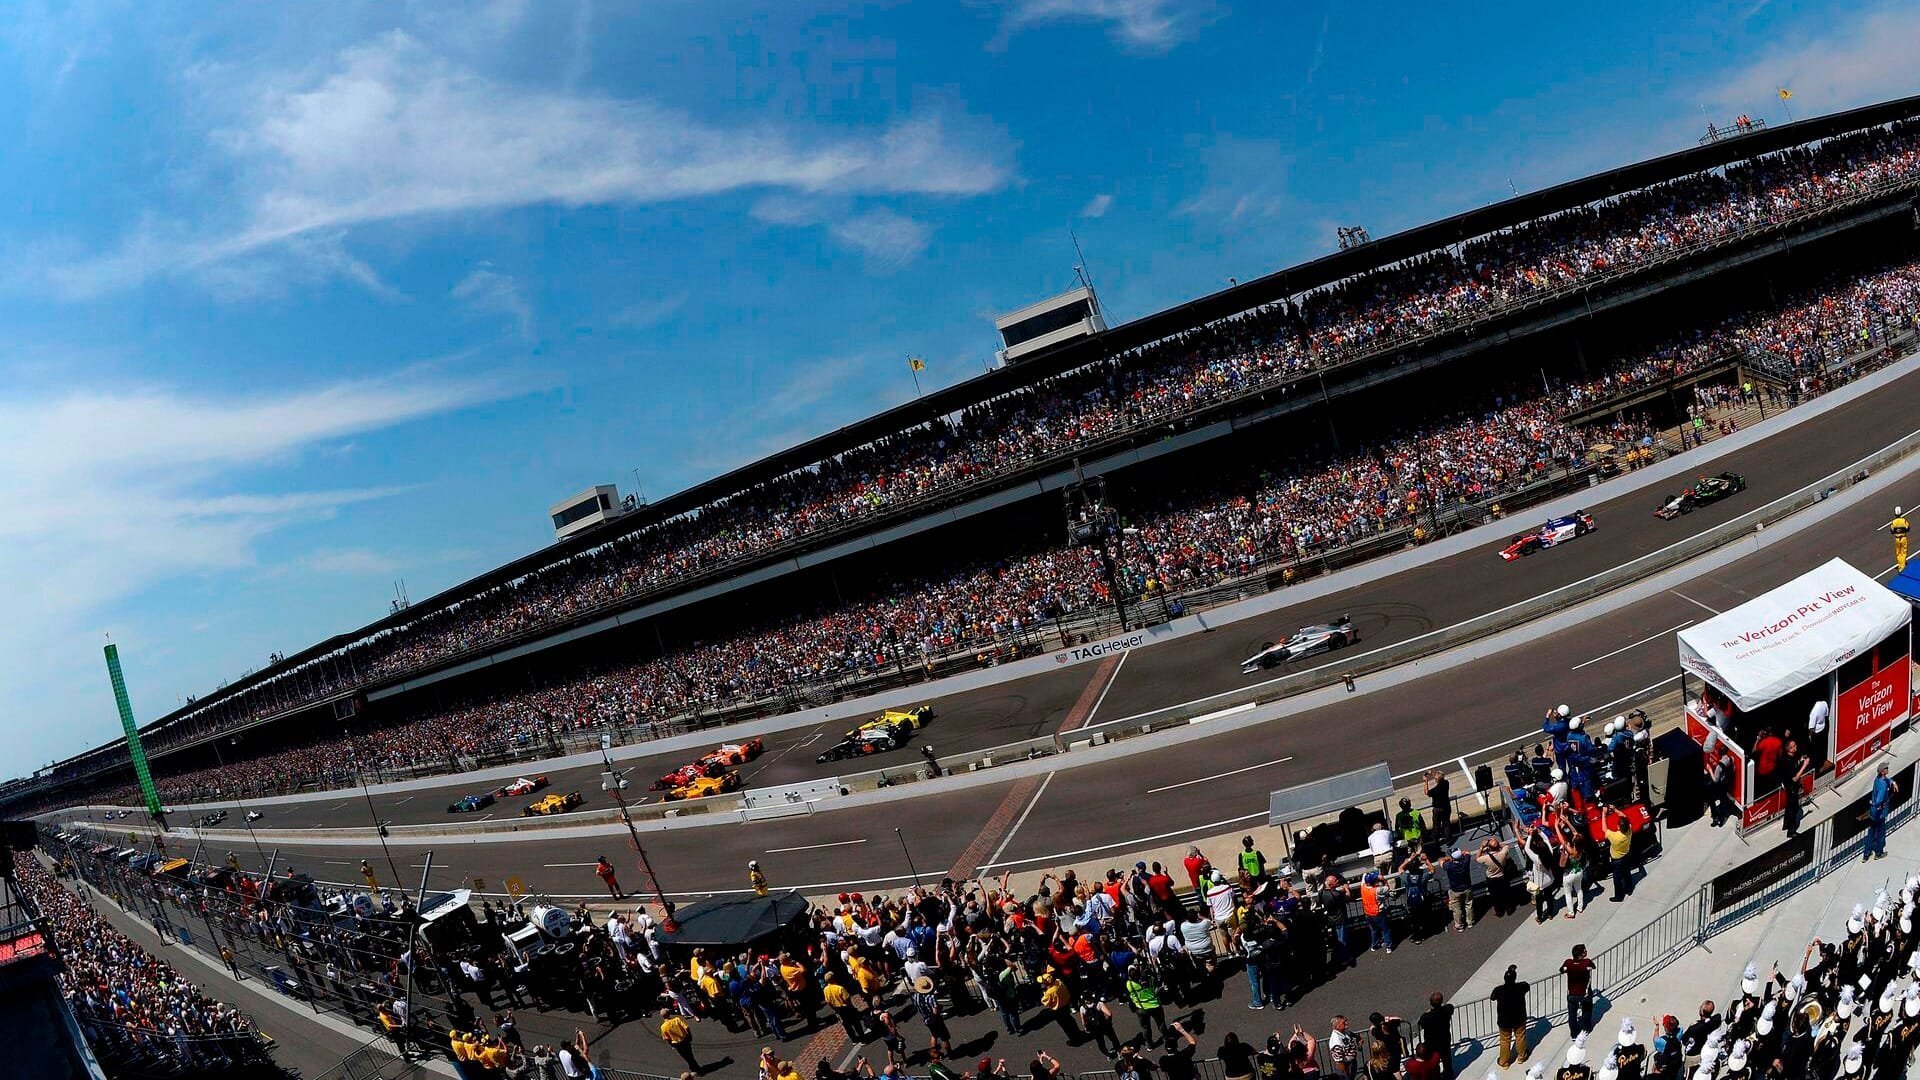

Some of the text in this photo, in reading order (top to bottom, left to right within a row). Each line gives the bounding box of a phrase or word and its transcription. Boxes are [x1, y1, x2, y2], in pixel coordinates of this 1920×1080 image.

[1721, 585, 1856, 649] The Verizon Pit View
[1859, 684, 1893, 712] Verizon
[1871, 680, 1881, 690] The
[1855, 699, 1894, 730] Pit View
[1752, 869, 1772, 884] CAPITAL
